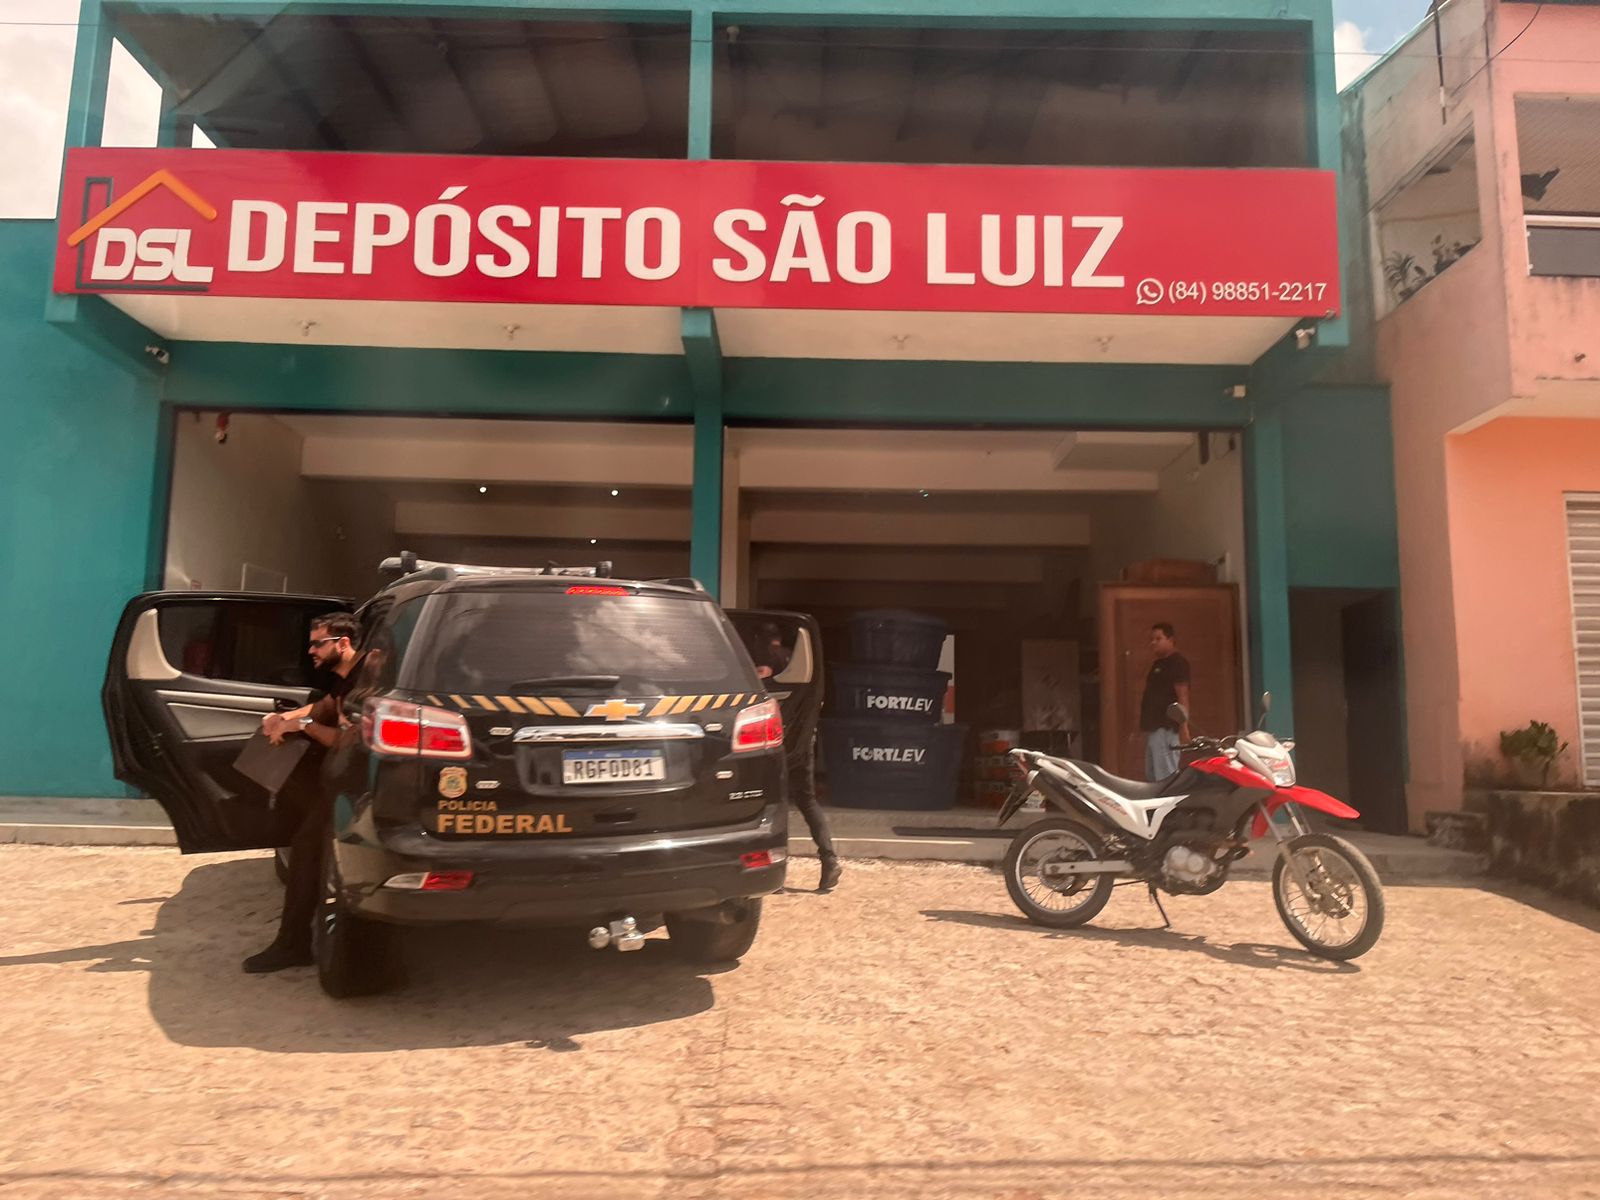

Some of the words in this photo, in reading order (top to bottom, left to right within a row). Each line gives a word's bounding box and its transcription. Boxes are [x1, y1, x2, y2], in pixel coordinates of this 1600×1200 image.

[227, 185, 681, 280] DEPÓSITO
[712, 193, 892, 284] SÃO
[927, 212, 1125, 288] LUIZ
[90, 227, 214, 283] DSL
[1168, 280, 1207, 304] (84)
[1212, 281, 1327, 301] 98851-2217
[866, 695, 933, 712] FORTLEV
[852, 747, 926, 762] FORTLEV
[437, 814, 573, 834] FEDERAL
